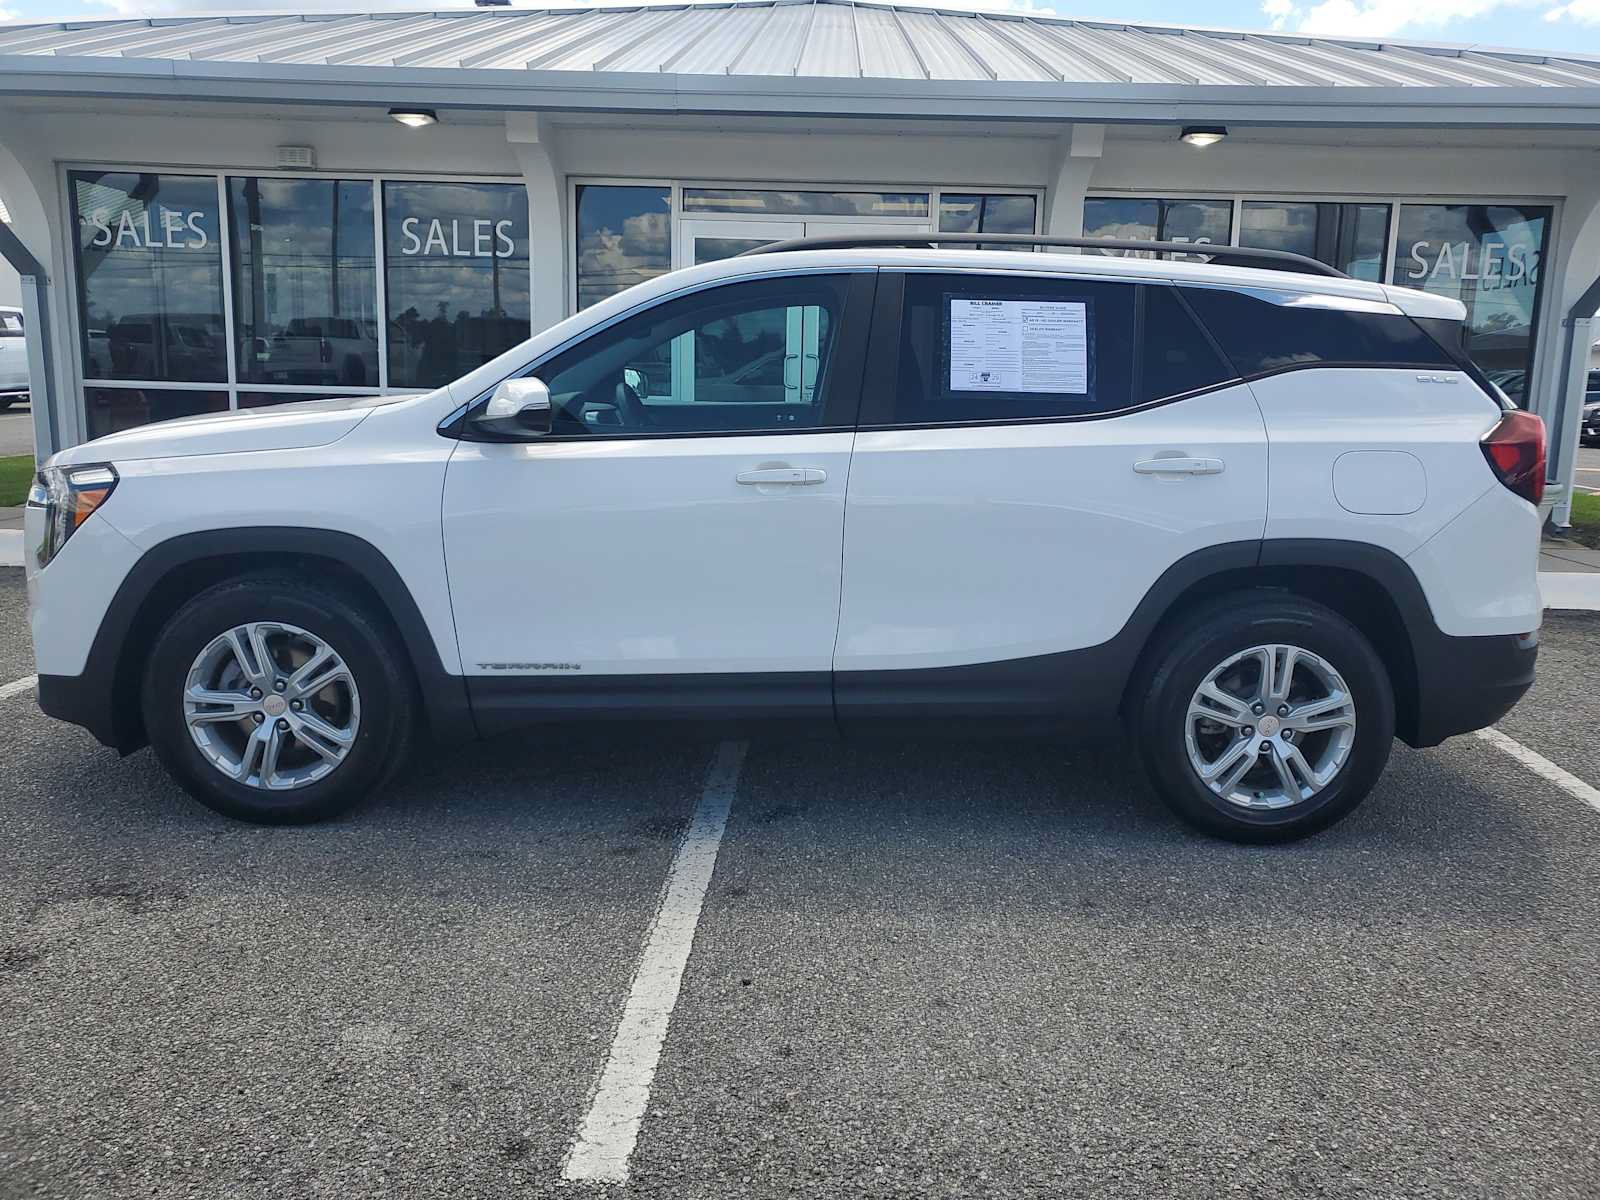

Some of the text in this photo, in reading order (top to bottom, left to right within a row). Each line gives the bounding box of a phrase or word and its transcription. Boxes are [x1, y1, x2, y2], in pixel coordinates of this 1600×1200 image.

[92, 209, 207, 249] SALES
[401, 217, 515, 258] SALES
[1408, 240, 1526, 280] SALES
[475, 663, 581, 671] TERRAIN
